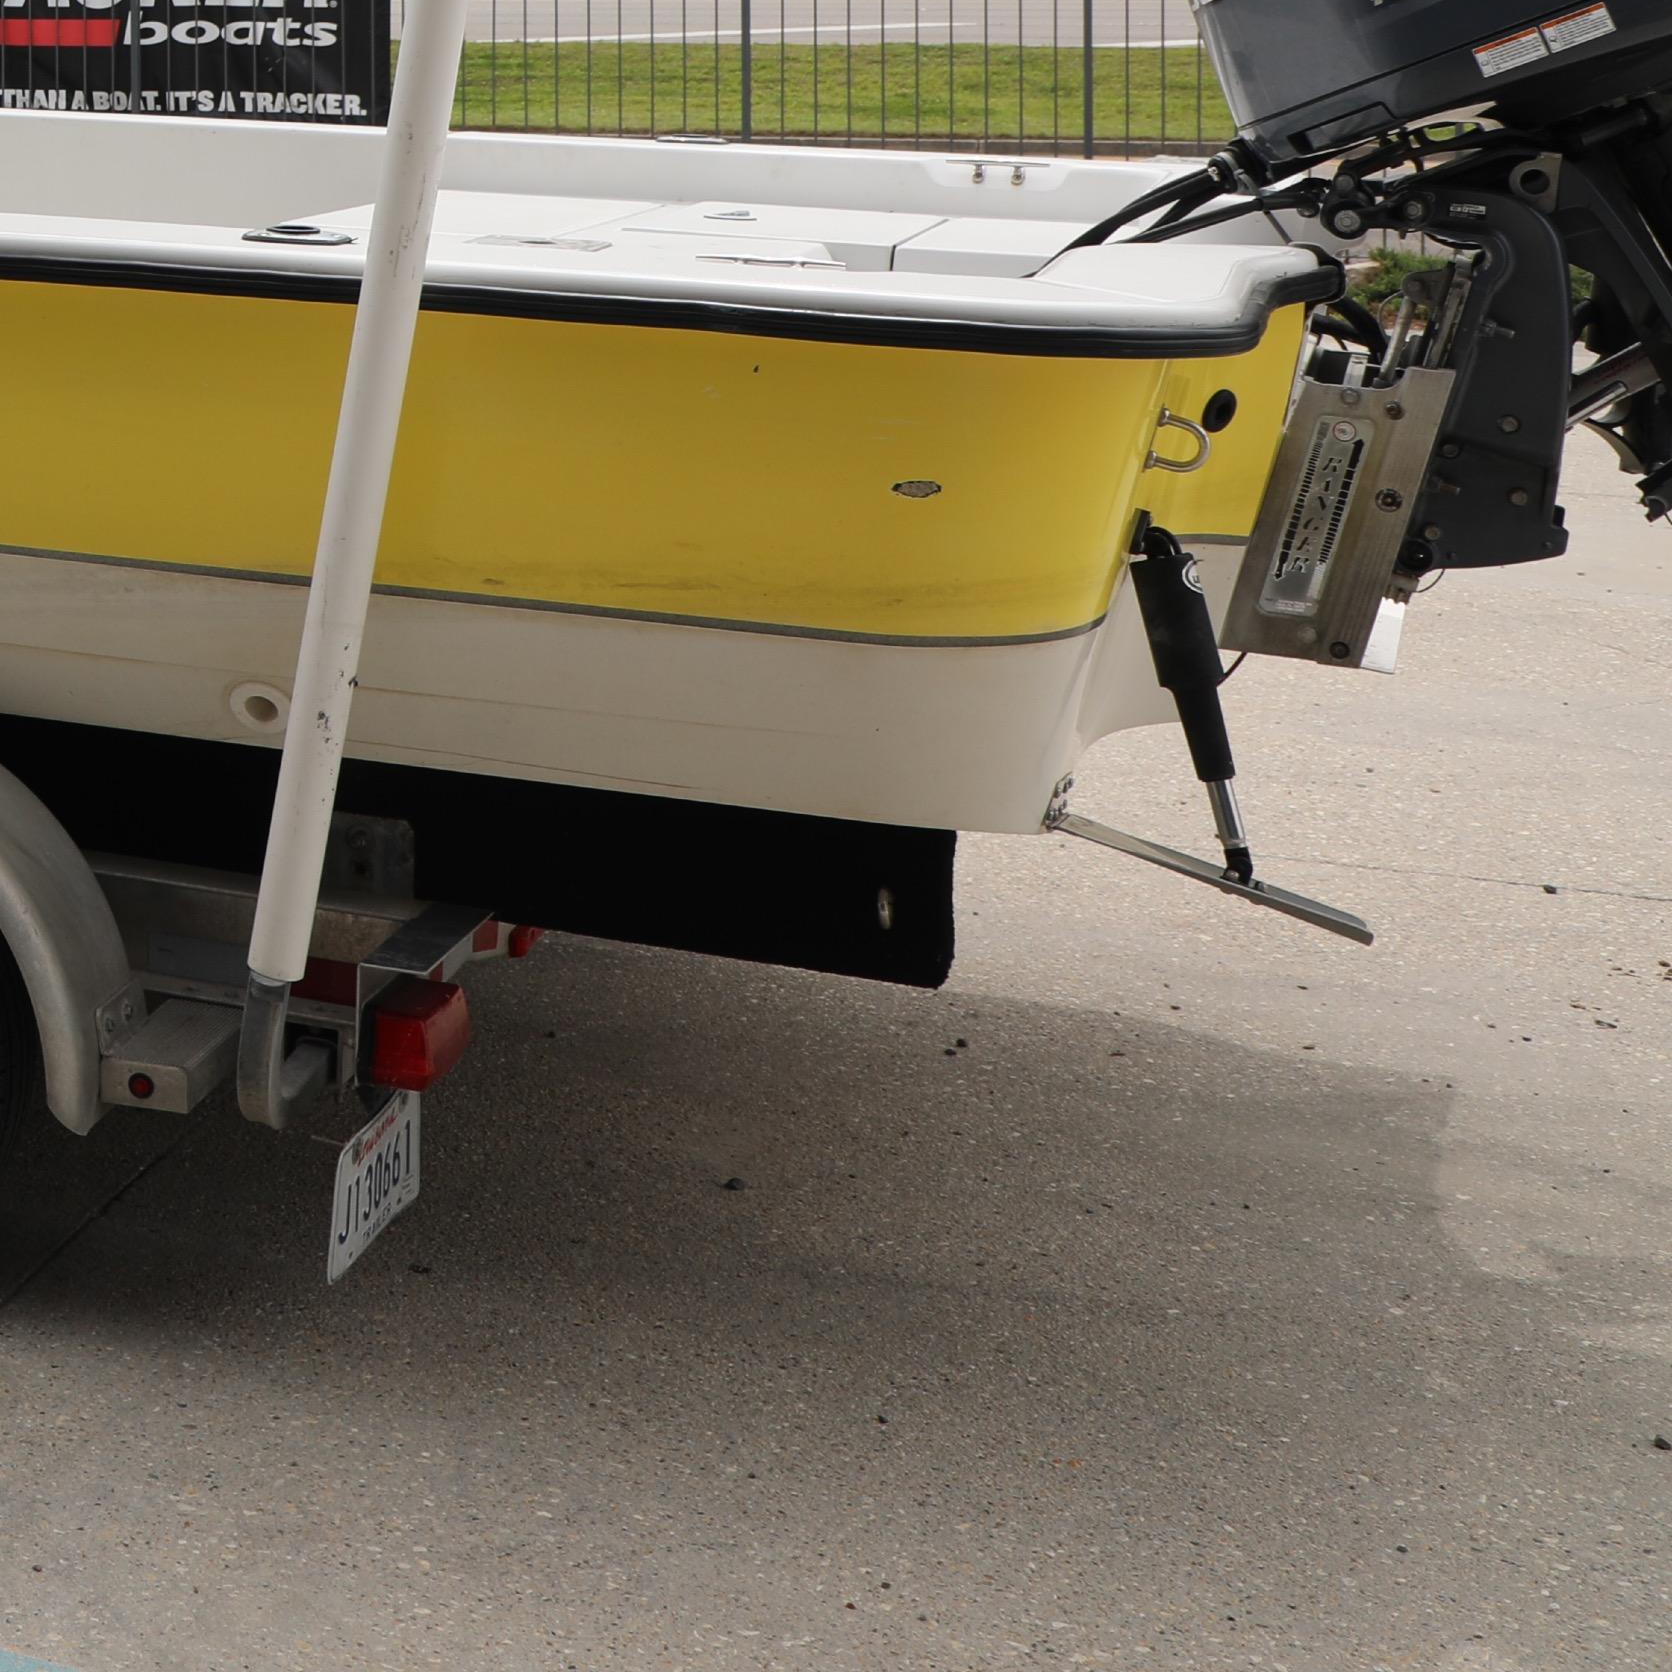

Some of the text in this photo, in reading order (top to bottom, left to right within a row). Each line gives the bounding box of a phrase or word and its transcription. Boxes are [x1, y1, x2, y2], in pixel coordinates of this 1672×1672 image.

[124, 11, 338, 47] boats
[0, 89, 66, 110] THAN
[72, 91, 88, 110] A
[166, 91, 214, 112] IT'S
[218, 91, 235, 112] A
[240, 92, 367, 116] TRACKER.
[338, 1120, 411, 1245] J130661
